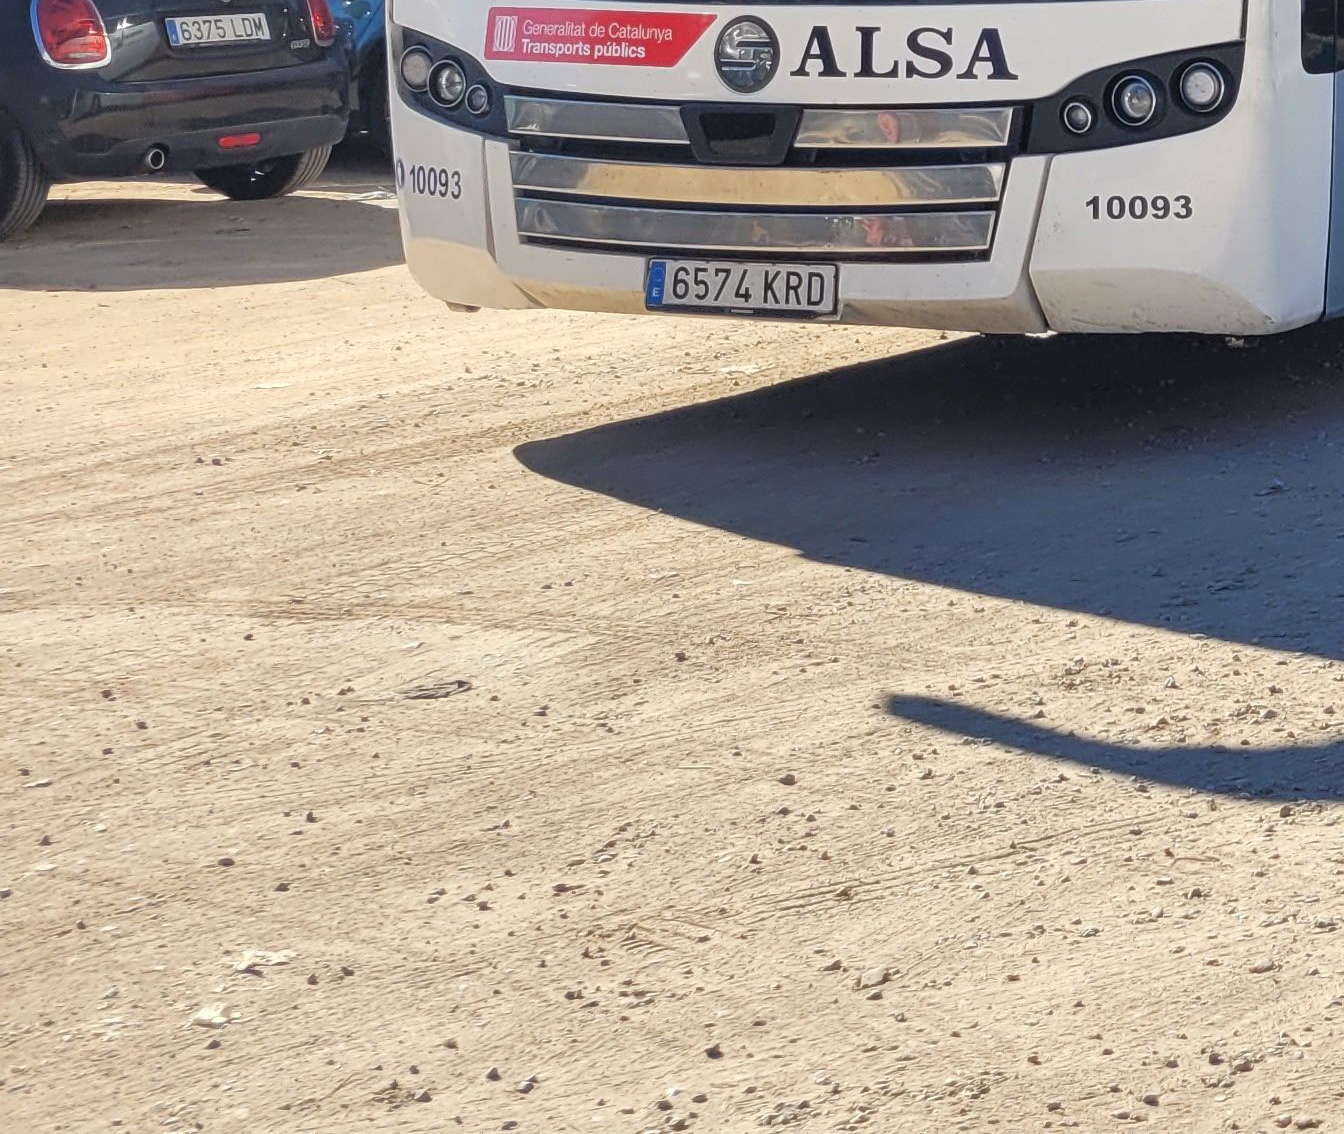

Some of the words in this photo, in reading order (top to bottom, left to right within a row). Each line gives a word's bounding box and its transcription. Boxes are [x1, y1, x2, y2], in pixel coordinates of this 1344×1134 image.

[180, 19, 227, 42] 6375
[230, 17, 265, 38] LDM
[522, 19, 586, 37] Generalitat
[589, 22, 605, 38] de
[608, 22, 673, 44] Catalunya
[521, 39, 591, 58] Transports
[594, 41, 646, 59] públics
[790, 25, 1019, 81] ALSA
[410, 165, 462, 200] 10093
[1086, 195, 1193, 219] 10093
[672, 266, 752, 303] 6574
[763, 269, 826, 306] KRD
